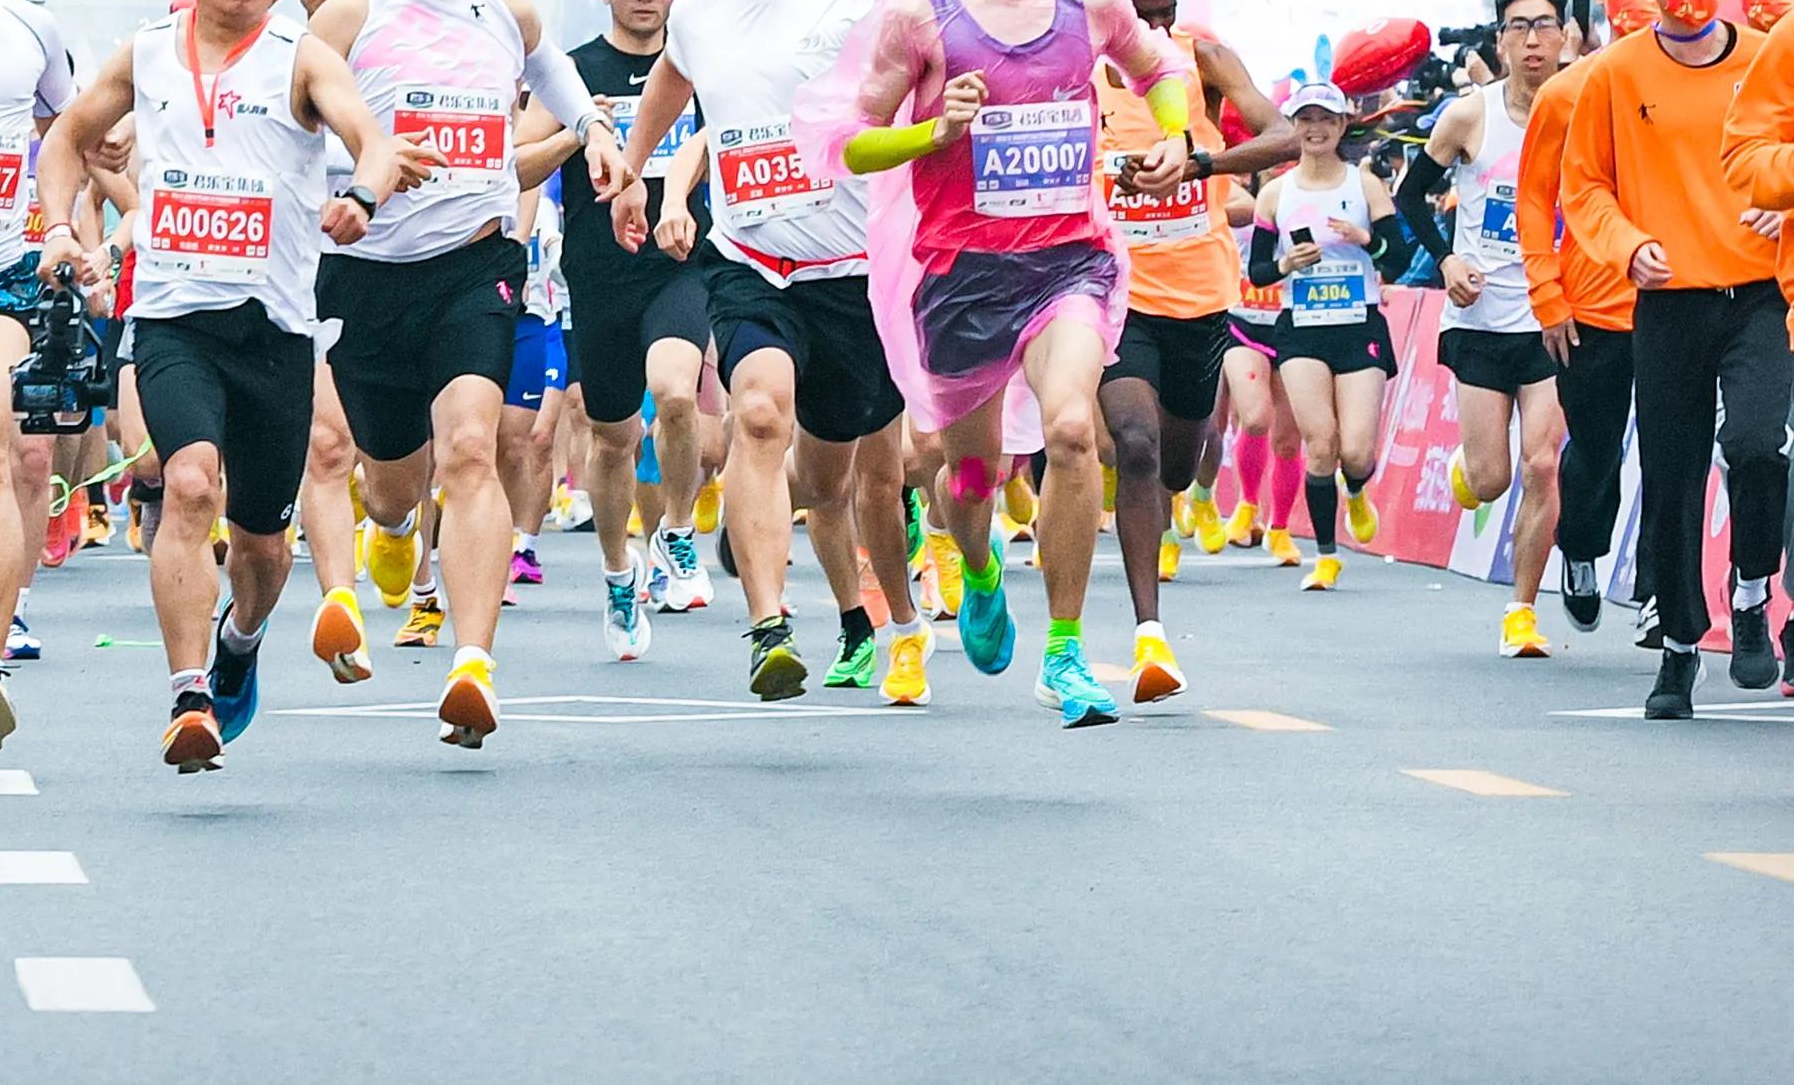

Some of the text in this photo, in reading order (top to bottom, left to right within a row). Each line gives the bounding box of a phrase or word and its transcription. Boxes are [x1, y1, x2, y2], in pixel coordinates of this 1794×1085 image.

[982, 142, 1088, 177] A20007
[156, 204, 265, 242] A00626
[1307, 284, 1351, 302] A304
